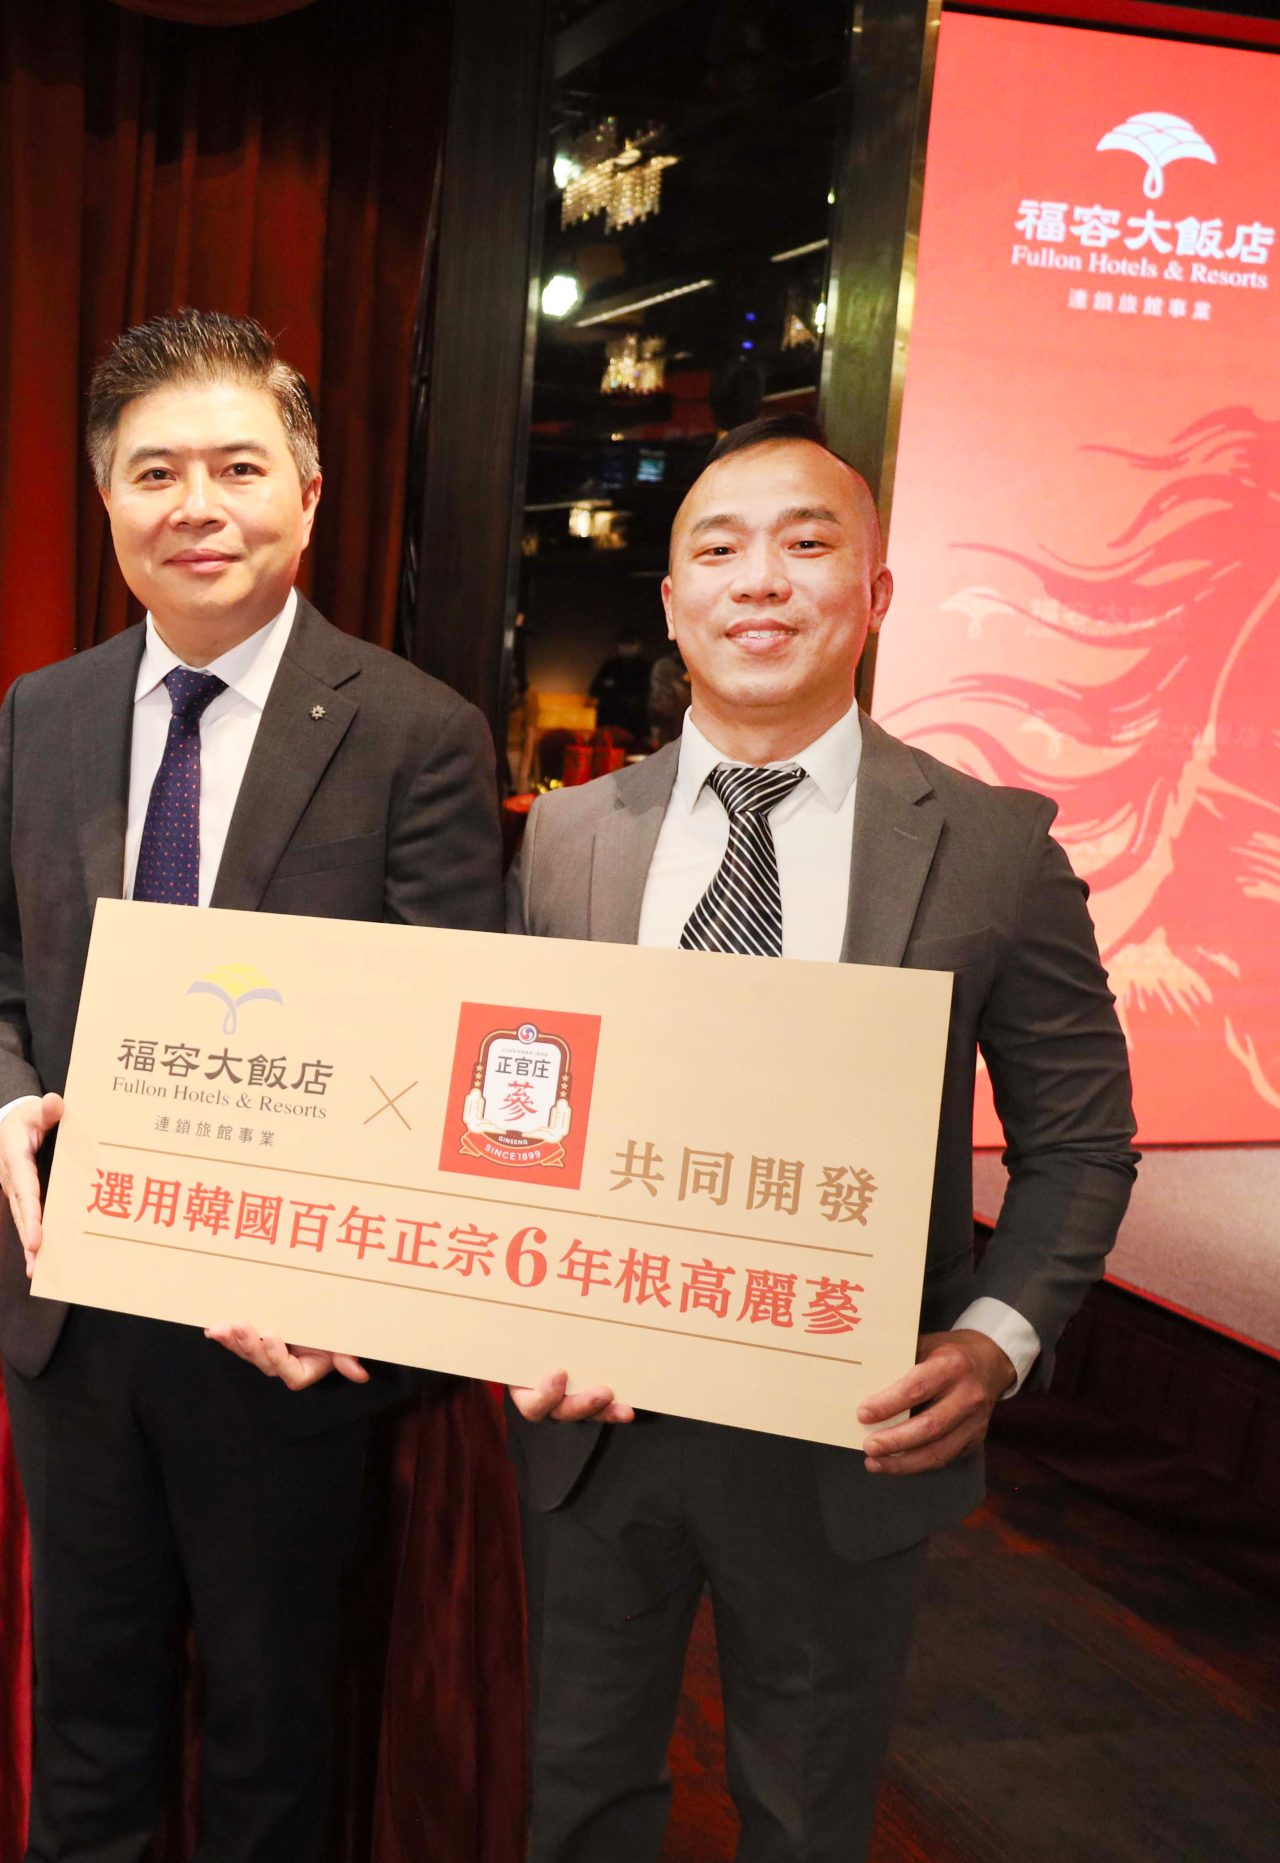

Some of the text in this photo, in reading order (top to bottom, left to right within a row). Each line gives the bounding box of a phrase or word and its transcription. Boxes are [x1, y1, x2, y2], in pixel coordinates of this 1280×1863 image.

[1015, 199, 1275, 264] 福容大飯店
[1011, 245, 1268, 289] Fullon Hotels & Resorts
[1067, 288, 1211, 320] 連鎖旅館事業
[117, 1038, 334, 1096] 福容大飯店
[495, 1055, 551, 1079] 正官庄
[112, 1075, 327, 1119] Fullon Hotels & Resorts
[499, 1081, 537, 1121] 蔘
[155, 1115, 276, 1147] 連鎖旅館事業
[498, 1136, 528, 1145] GINSENG
[484, 1144, 541, 1161] SINCE 1899
[609, 1139, 879, 1226] 共同開發
[87, 1168, 865, 1335] 選用韓國百年正宗6年根高麗蔘
